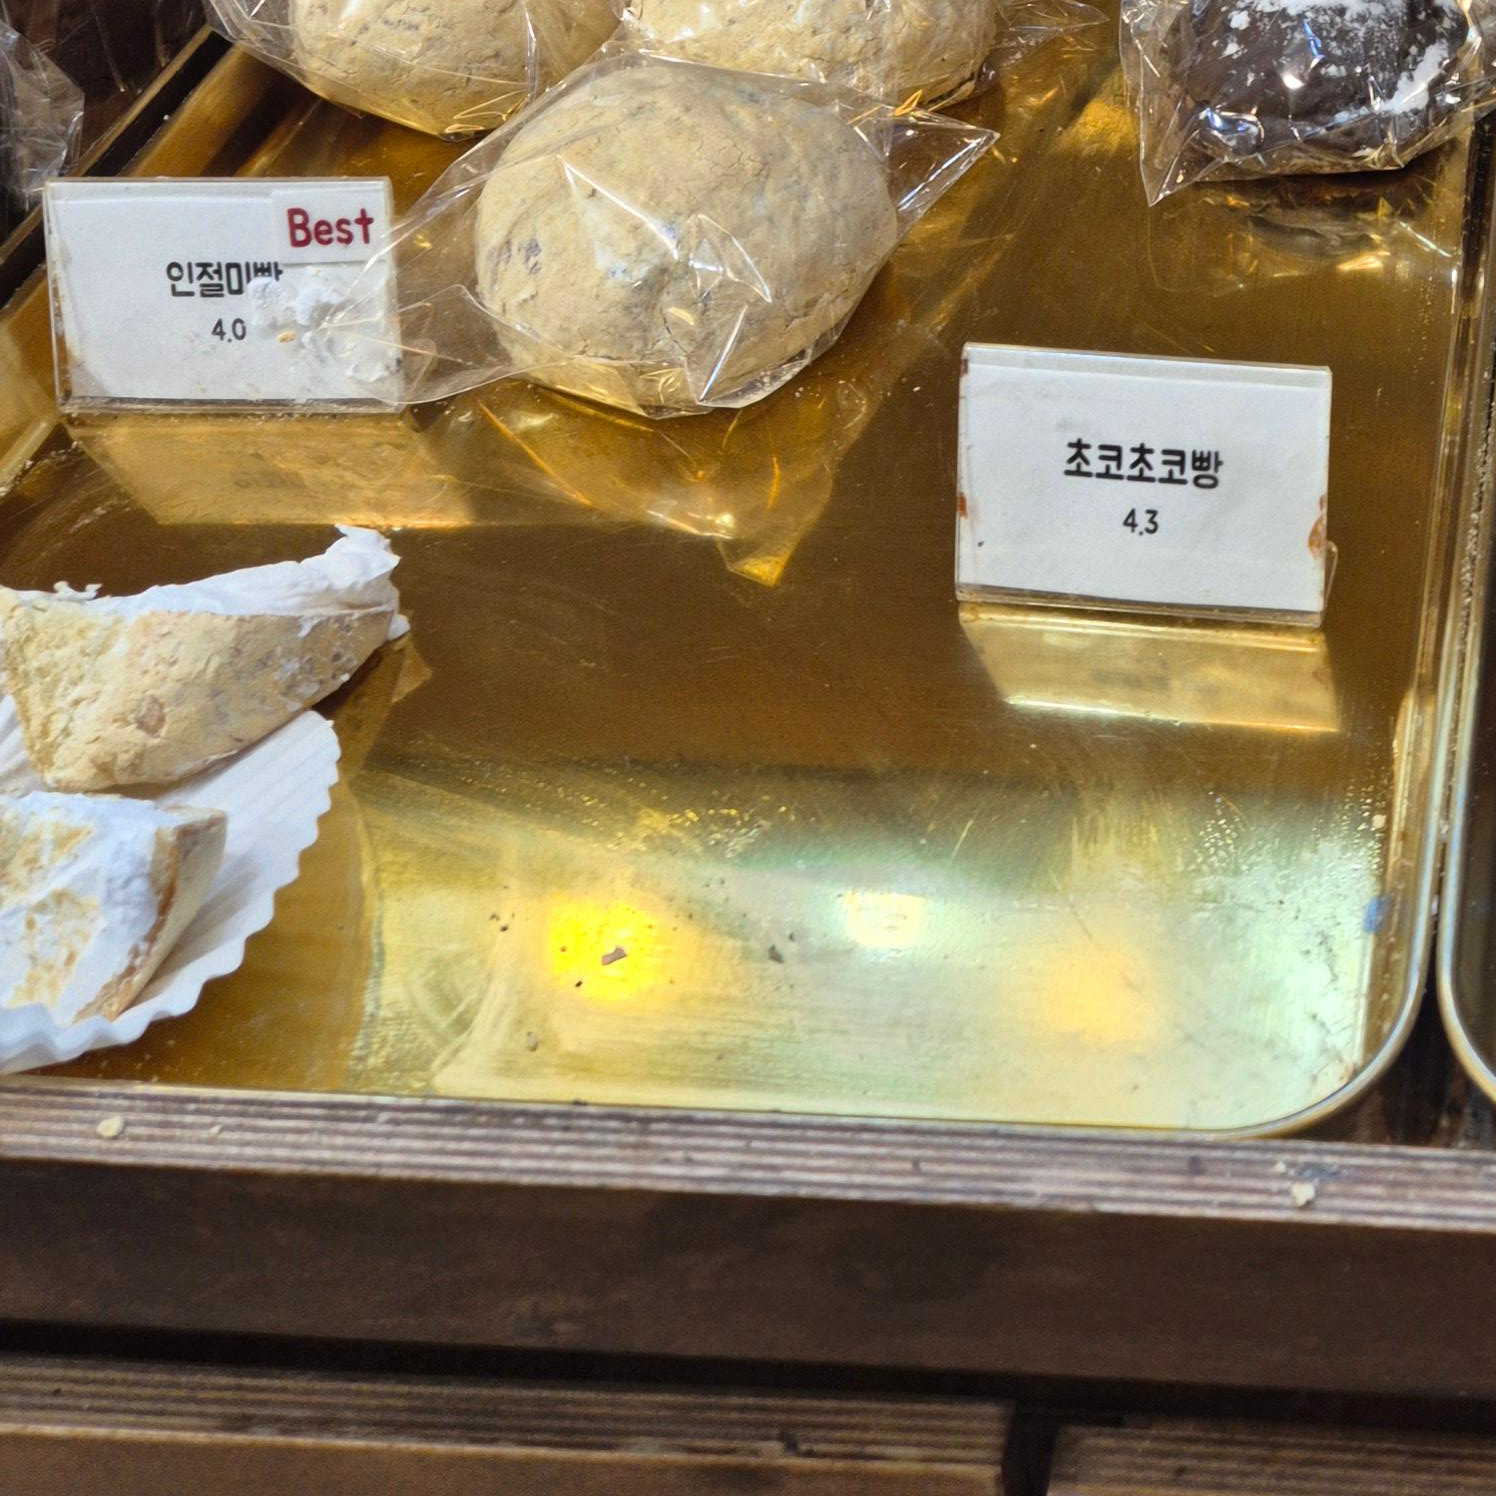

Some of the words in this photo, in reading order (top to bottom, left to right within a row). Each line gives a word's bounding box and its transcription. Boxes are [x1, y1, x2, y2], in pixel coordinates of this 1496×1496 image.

[286, 207, 375, 248] Best
[211, 317, 247, 342] 4.0
[1063, 437, 1224, 490] 초코초코빵
[1122, 507, 1159, 536] 4.3
